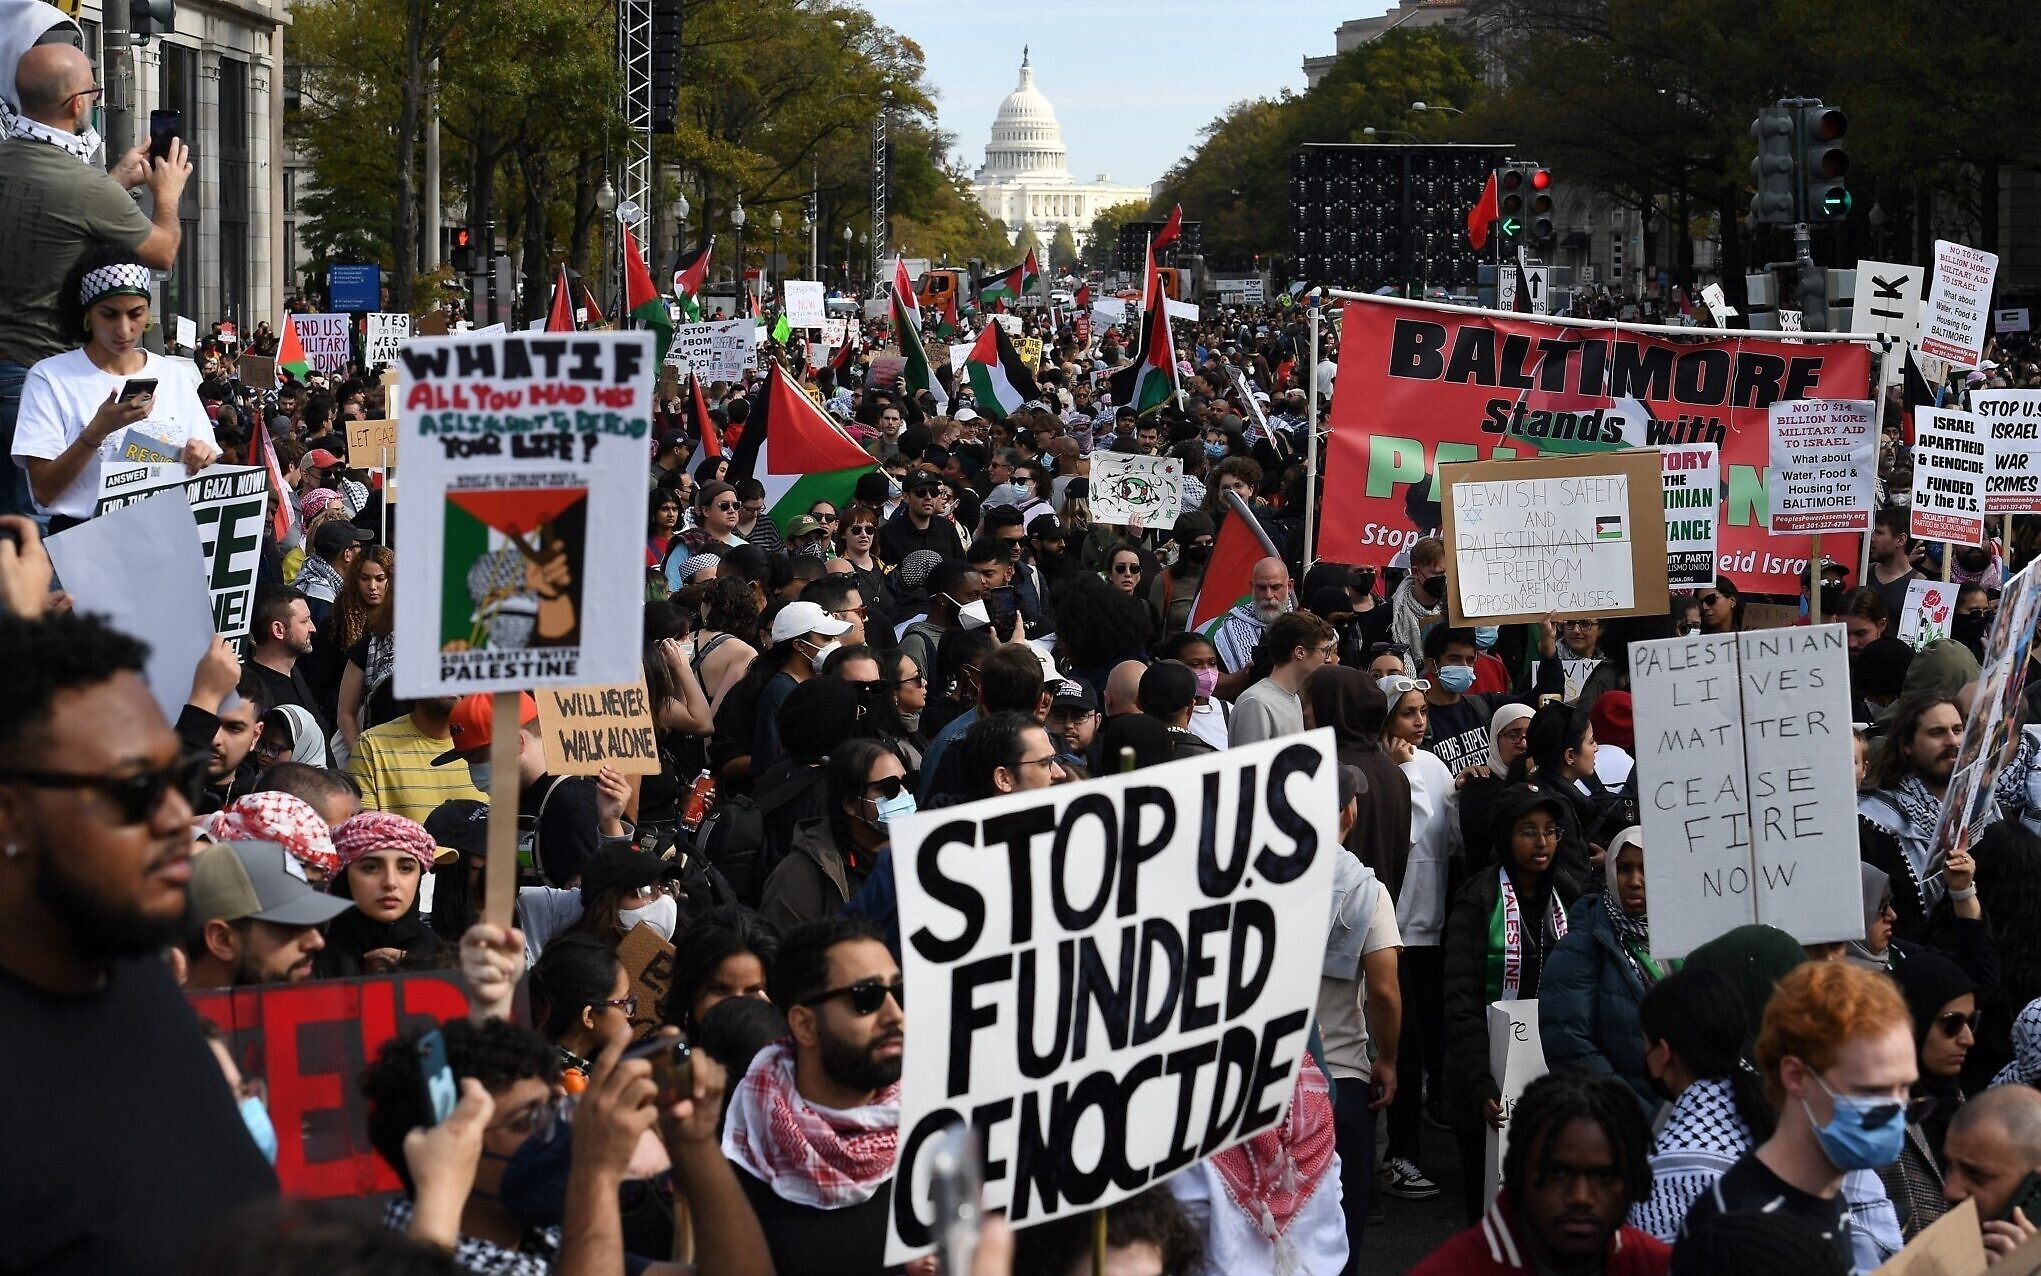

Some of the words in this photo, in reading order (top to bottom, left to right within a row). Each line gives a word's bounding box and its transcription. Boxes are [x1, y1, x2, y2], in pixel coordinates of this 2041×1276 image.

[1939, 253, 1969, 268] BILLION
[1969, 263, 1991, 275] MORE
[1939, 264, 1972, 280] MILITARY
[1973, 275, 1989, 285] AID
[1951, 277, 1978, 292] ISRAEL
[1943, 289, 1957, 300] What
[1957, 296, 1976, 307] about
[1936, 300, 1953, 315] Water,
[1954, 308, 1971, 319] Food
[1971, 312, 1978, 321] &
[294, 320, 319, 337] END
[323, 319, 345, 337] U.S.
[379, 315, 407, 328] YES
[392, 327, 404, 335] the
[1936, 314, 1960, 330] Housing
[1961, 321, 1972, 332] for
[1013, 340, 1027, 348] END
[1028, 340, 1042, 348] THE
[1931, 325, 1973, 345] BALTIMORE!
[400, 338, 568, 381] WHAT
[568, 341, 643, 384] IF
[1024, 347, 1040, 356] WAR
[1387, 317, 1825, 409] BALTIMORE
[406, 378, 469, 411] ALL
[470, 382, 523, 412] YOU
[529, 382, 587, 407] HAD
[1792, 404, 1810, 413] NO
[1814, 403, 1829, 412] TO
[1832, 402, 1853, 411] $14
[1979, 400, 2020, 417] STOP
[418, 412, 440, 437] A
[1480, 398, 1626, 445] Stands
[1646, 413, 1728, 450] with
[1777, 415, 1827, 425] BILLION
[1831, 414, 1867, 423] MORE
[1933, 416, 1975, 435] ISRAEL
[350, 428, 370, 448] LET
[1778, 426, 1838, 437] MILITARY
[1842, 426, 1866, 434] AID
[1991, 422, 2039, 440] ISRAEL
[438, 432, 502, 459] YOUR
[509, 431, 599, 464] LIFE?
[1784, 440, 1800, 449] TO
[1803, 437, 1850, 447] ISRAEL
[1919, 434, 1985, 456] APARTHEID
[1792, 455, 1818, 464] What
[1821, 453, 1851, 463] about
[1918, 453, 1928, 466] &
[1931, 455, 1984, 475] GENOCIDE
[1995, 453, 2029, 470] WAR
[107, 470, 146, 487] ANSWER
[1663, 474, 1687, 487] THE
[1782, 471, 1816, 481] Water,
[1819, 468, 1847, 479] Food
[1850, 468, 1858, 478] &
[1985, 475, 2039, 492] CRIMES
[187, 482, 202, 505] ON
[204, 477, 233, 500] GAZA
[236, 470, 267, 496] NOW!
[1457, 482, 1547, 508] JEWISH
[1560, 478, 1627, 506] SAFETY
[1788, 483, 1833, 495] Housing
[1836, 482, 1852, 492] for
[1926, 476, 1974, 496] FUNDED
[1783, 496, 1857, 509] BALTIMORE!
[1916, 491, 1931, 508] by
[1935, 493, 1955, 508] the
[1957, 496, 1980, 513] U.S.
[1524, 511, 1556, 528] AND
[1775, 512, 1866, 522] PeoplesPowerAssembly.org
[1791, 522, 1806, 530] Text
[1914, 520, 1933, 529] PARTIDO
[1940, 522, 1966, 533] SOCIALISMO
[1921, 512, 1945, 522] SOCIALIST
[1960, 518, 1974, 526] PARTY
[1361, 522, 1419, 554] Stop
[1459, 528, 1594, 563] PALESTINIAN
[1685, 553, 1712, 564] PARTY
[1688, 563, 1710, 571] UNIDO
[1487, 558, 1582, 585] FREEDOM
[1519, 583, 1541, 595] ARE
[1546, 581, 1570, 593] NOT
[1464, 594, 1537, 615] OPPOSING
[1558, 591, 1619, 609] CAUSES.
[440, 651, 532, 665] SOLIDARITY
[538, 649, 580, 661] WITH
[1635, 629, 1843, 677] PALESTINIAN
[440, 660, 578, 682] PALESTINE
[1672, 667, 1825, 707] LIVES
[553, 690, 602, 719] WILL
[600, 687, 649, 719] NEVER
[1657, 711, 1830, 754] MATTER
[558, 728, 607, 763] WALK
[607, 726, 656, 759] ALONE
[1654, 767, 1815, 811] CEASE
[1684, 801, 1823, 853] FIRE
[909, 784, 1177, 964] STOP
[1703, 861, 1797, 898] NOW
[1502, 881, 1521, 990] PALESTINE
[947, 898, 1277, 1099] FUNDED
[893, 1007, 1310, 1250] GENOCIDE
